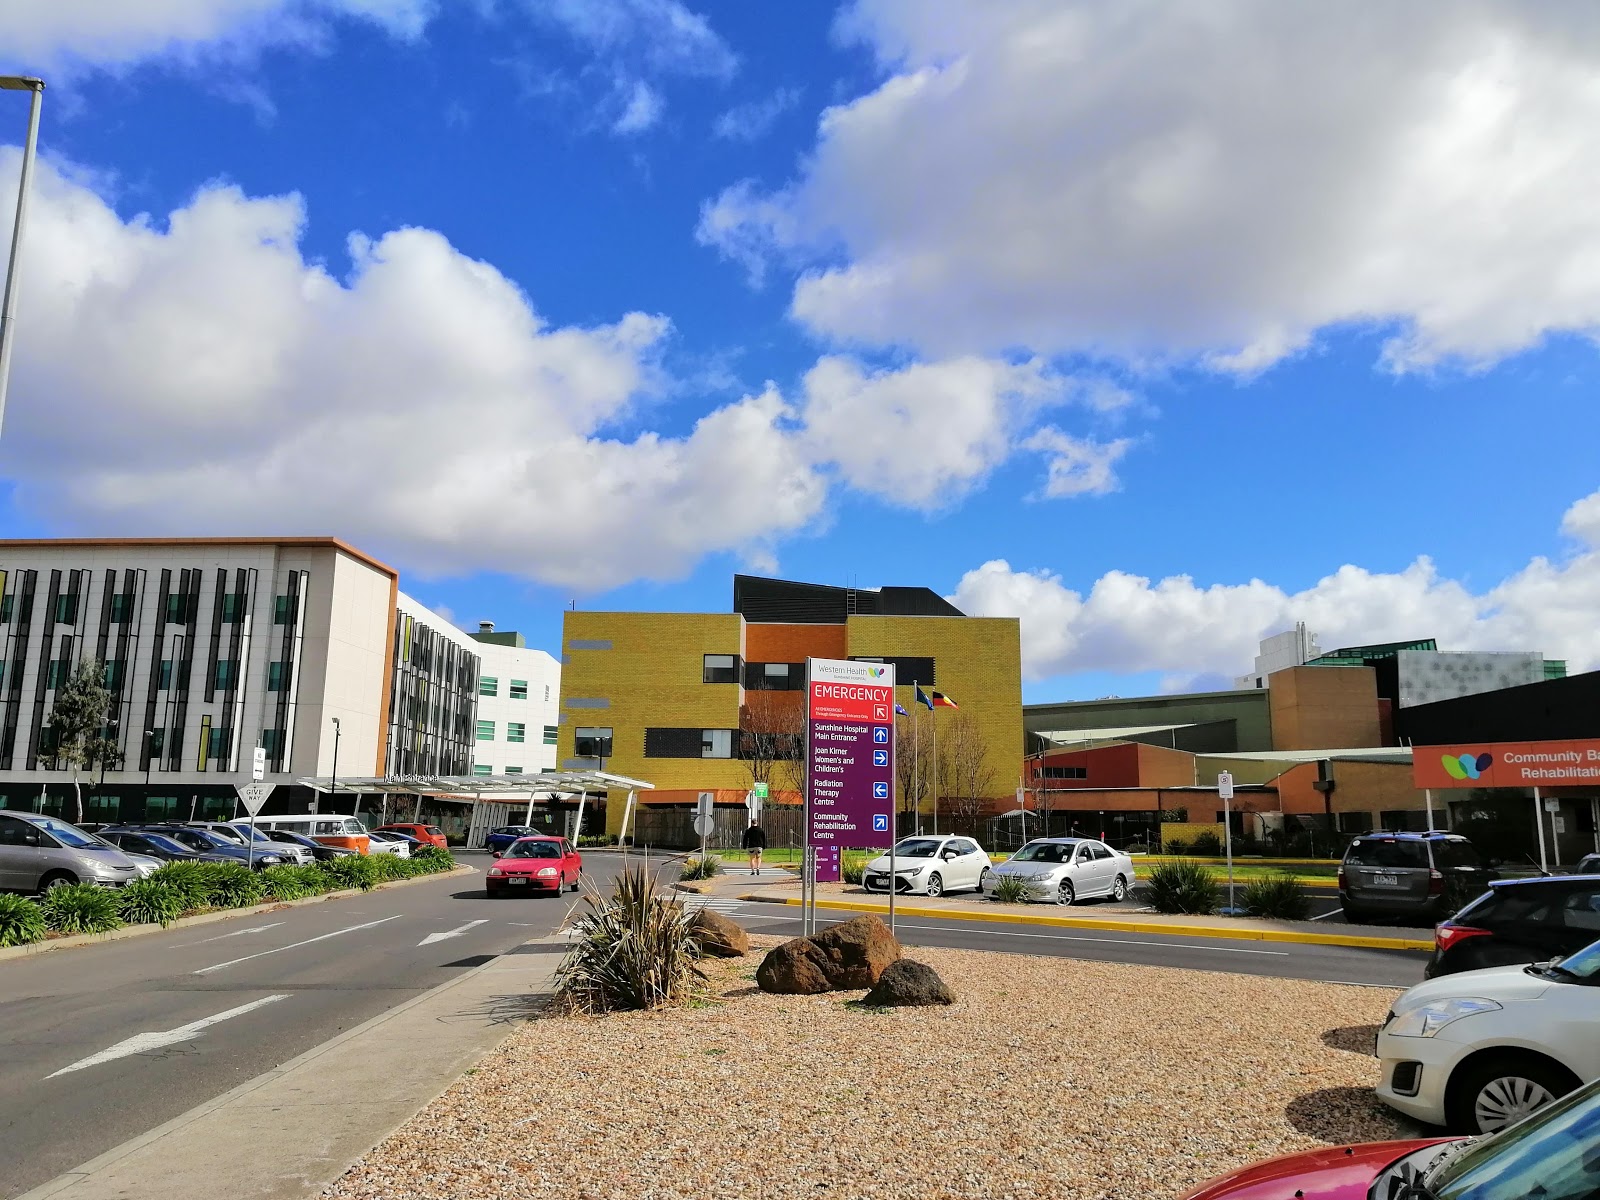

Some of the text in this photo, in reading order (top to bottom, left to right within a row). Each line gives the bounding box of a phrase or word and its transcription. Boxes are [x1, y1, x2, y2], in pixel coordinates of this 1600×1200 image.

[818, 664, 867, 676] Western Health
[815, 684, 888, 701] EMERGENCY
[815, 723, 868, 734] Sunshine Hospital
[815, 732, 857, 741] Main Entrance
[814, 746, 848, 755] Joan Kirner
[814, 755, 842, 764] Women's
[1503, 751, 1582, 763] Community
[814, 764, 844, 773] Children's
[1521, 766, 1600, 778] Rehabilitati
[404, 773, 439, 783] Entrance
[814, 779, 844, 787] Radiation
[814, 788, 840, 798] Therapy
[813, 797, 835, 806] Centre
[813, 812, 848, 822] Community
[813, 821, 857, 830] Rehabilitation
[813, 831, 835, 839] Centre
